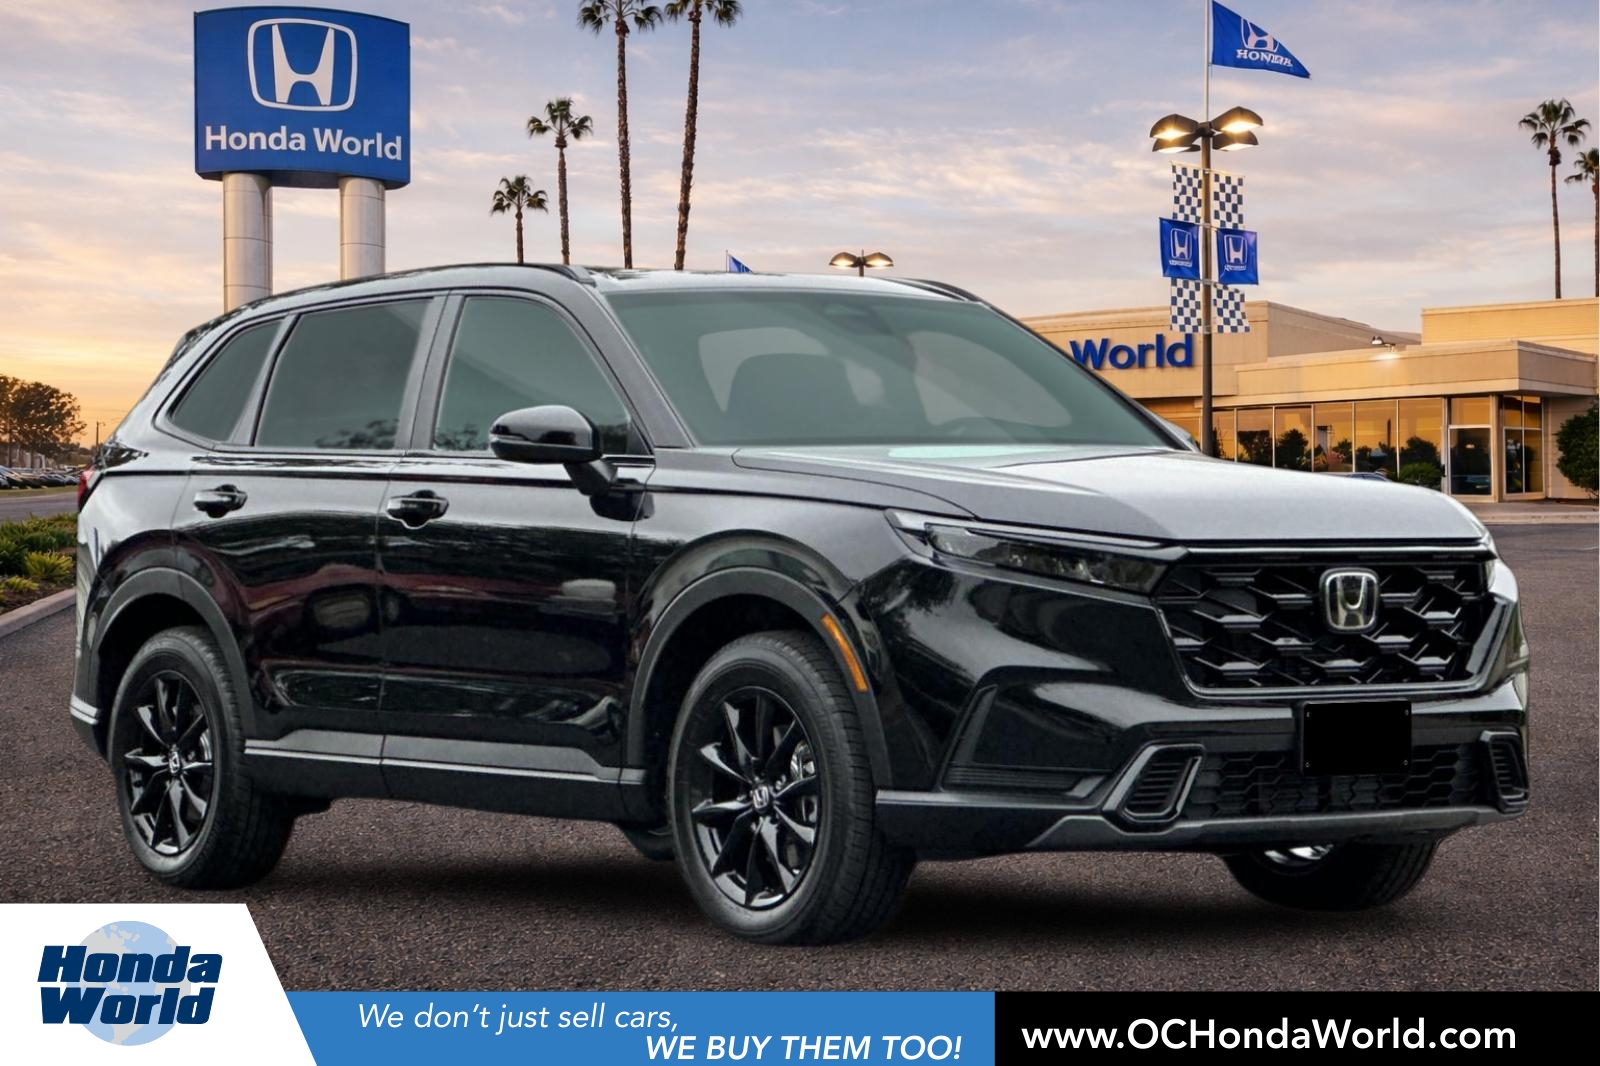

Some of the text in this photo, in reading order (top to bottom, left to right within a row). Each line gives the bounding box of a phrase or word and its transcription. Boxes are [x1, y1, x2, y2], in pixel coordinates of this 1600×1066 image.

[205, 125, 402, 161] Honda World
[1069, 333, 1194, 370] World
